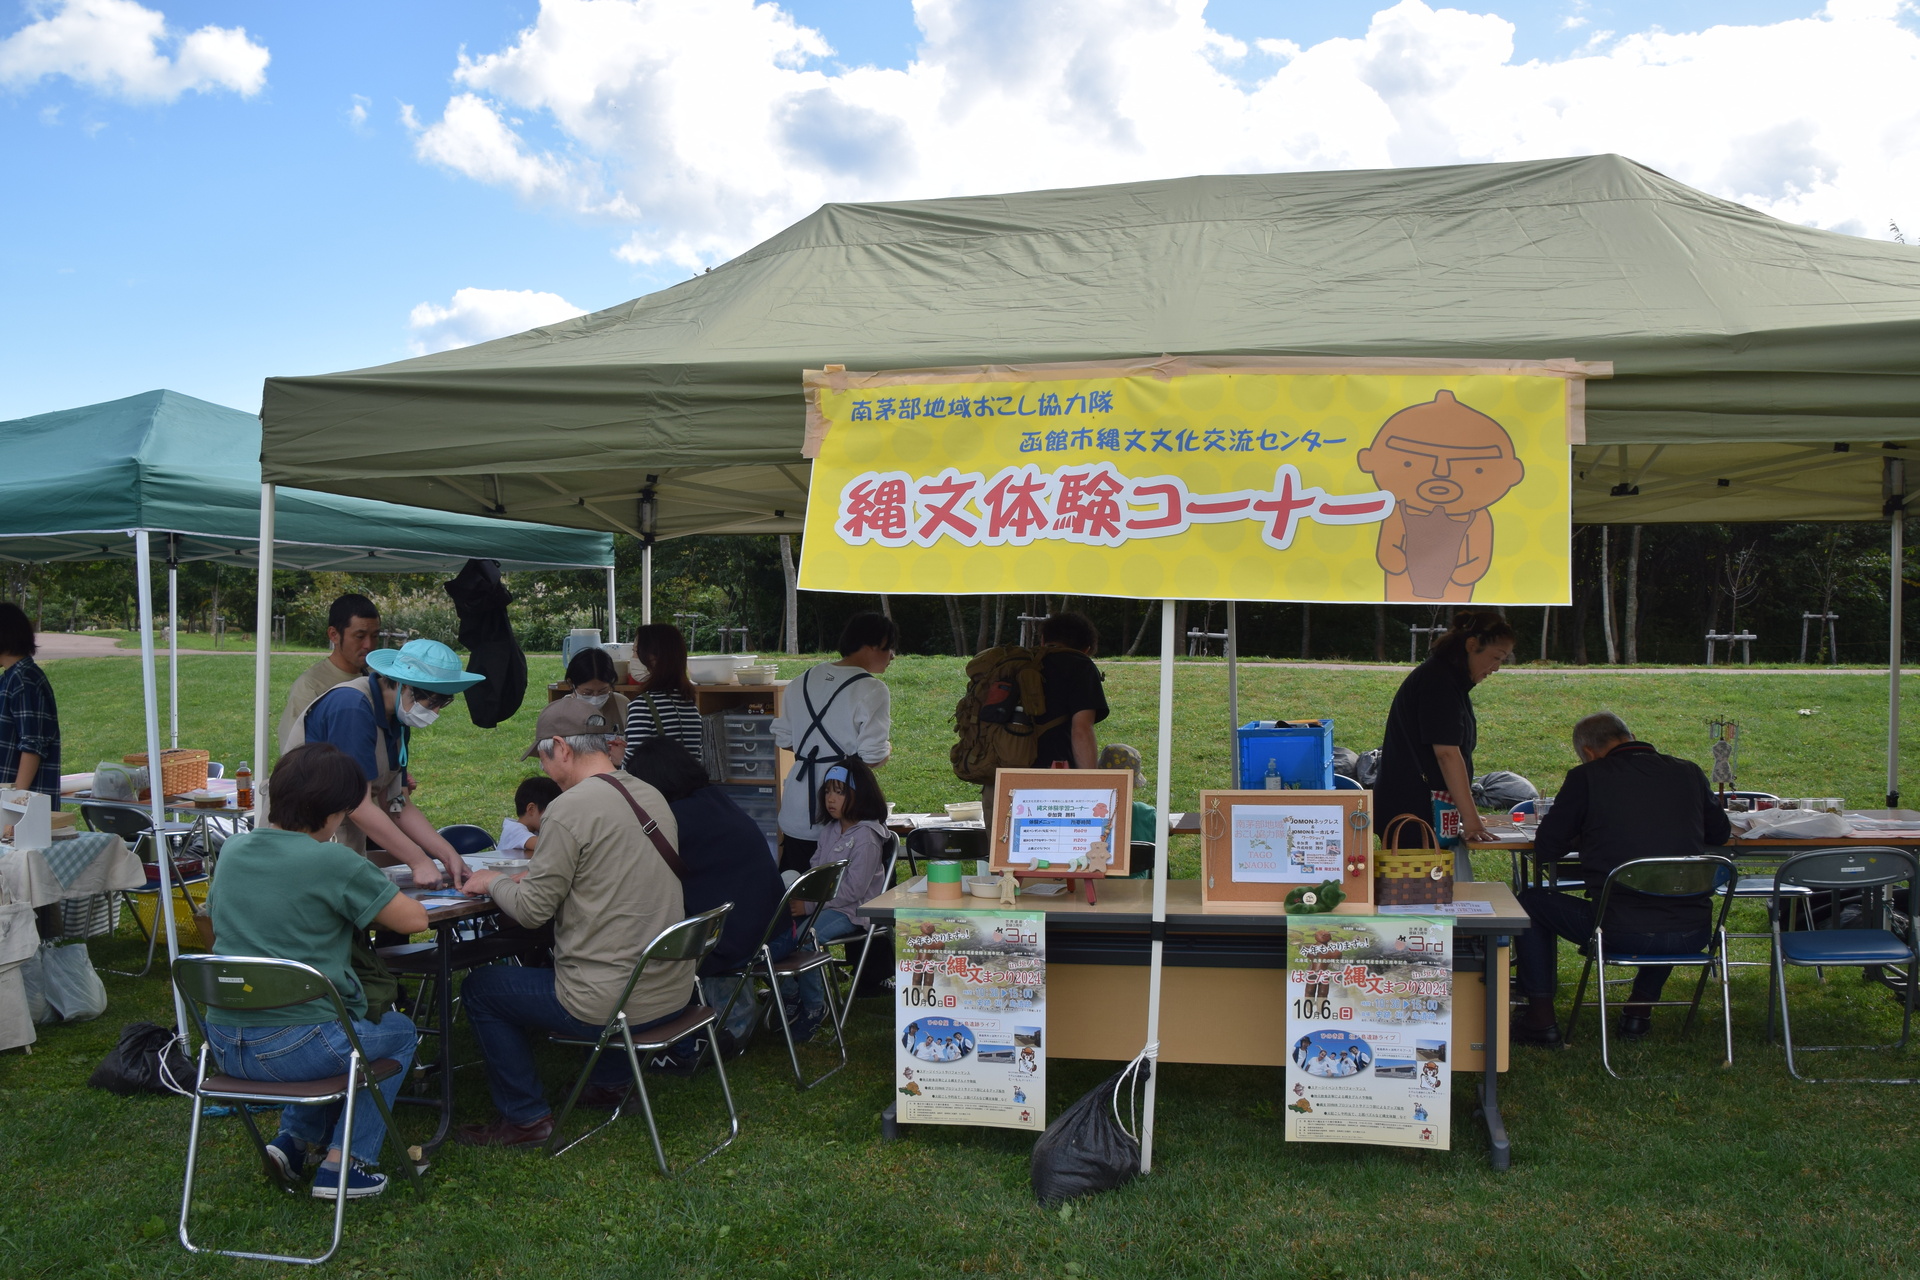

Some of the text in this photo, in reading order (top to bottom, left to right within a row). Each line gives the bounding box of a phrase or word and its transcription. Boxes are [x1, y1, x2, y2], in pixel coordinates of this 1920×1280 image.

[851, 389, 1114, 422] 南茅部地域おこし協力隊
[1019, 427, 1347, 453] 函館市縄文文化交流センター
[842, 470, 1386, 541] 縄文体験コーナー
[1234, 830, 1285, 839] おこし協力隊
[1236, 821, 1284, 829] 南茅部地域
[1441, 811, 1460, 836] 贈
[1005, 927, 1038, 944] 3rd
[1408, 936, 1444, 952] 3rd
[900, 956, 1042, 985] はこだて縄文まつり2024
[1291, 966, 1447, 995] はこだて縄文まつり2024
